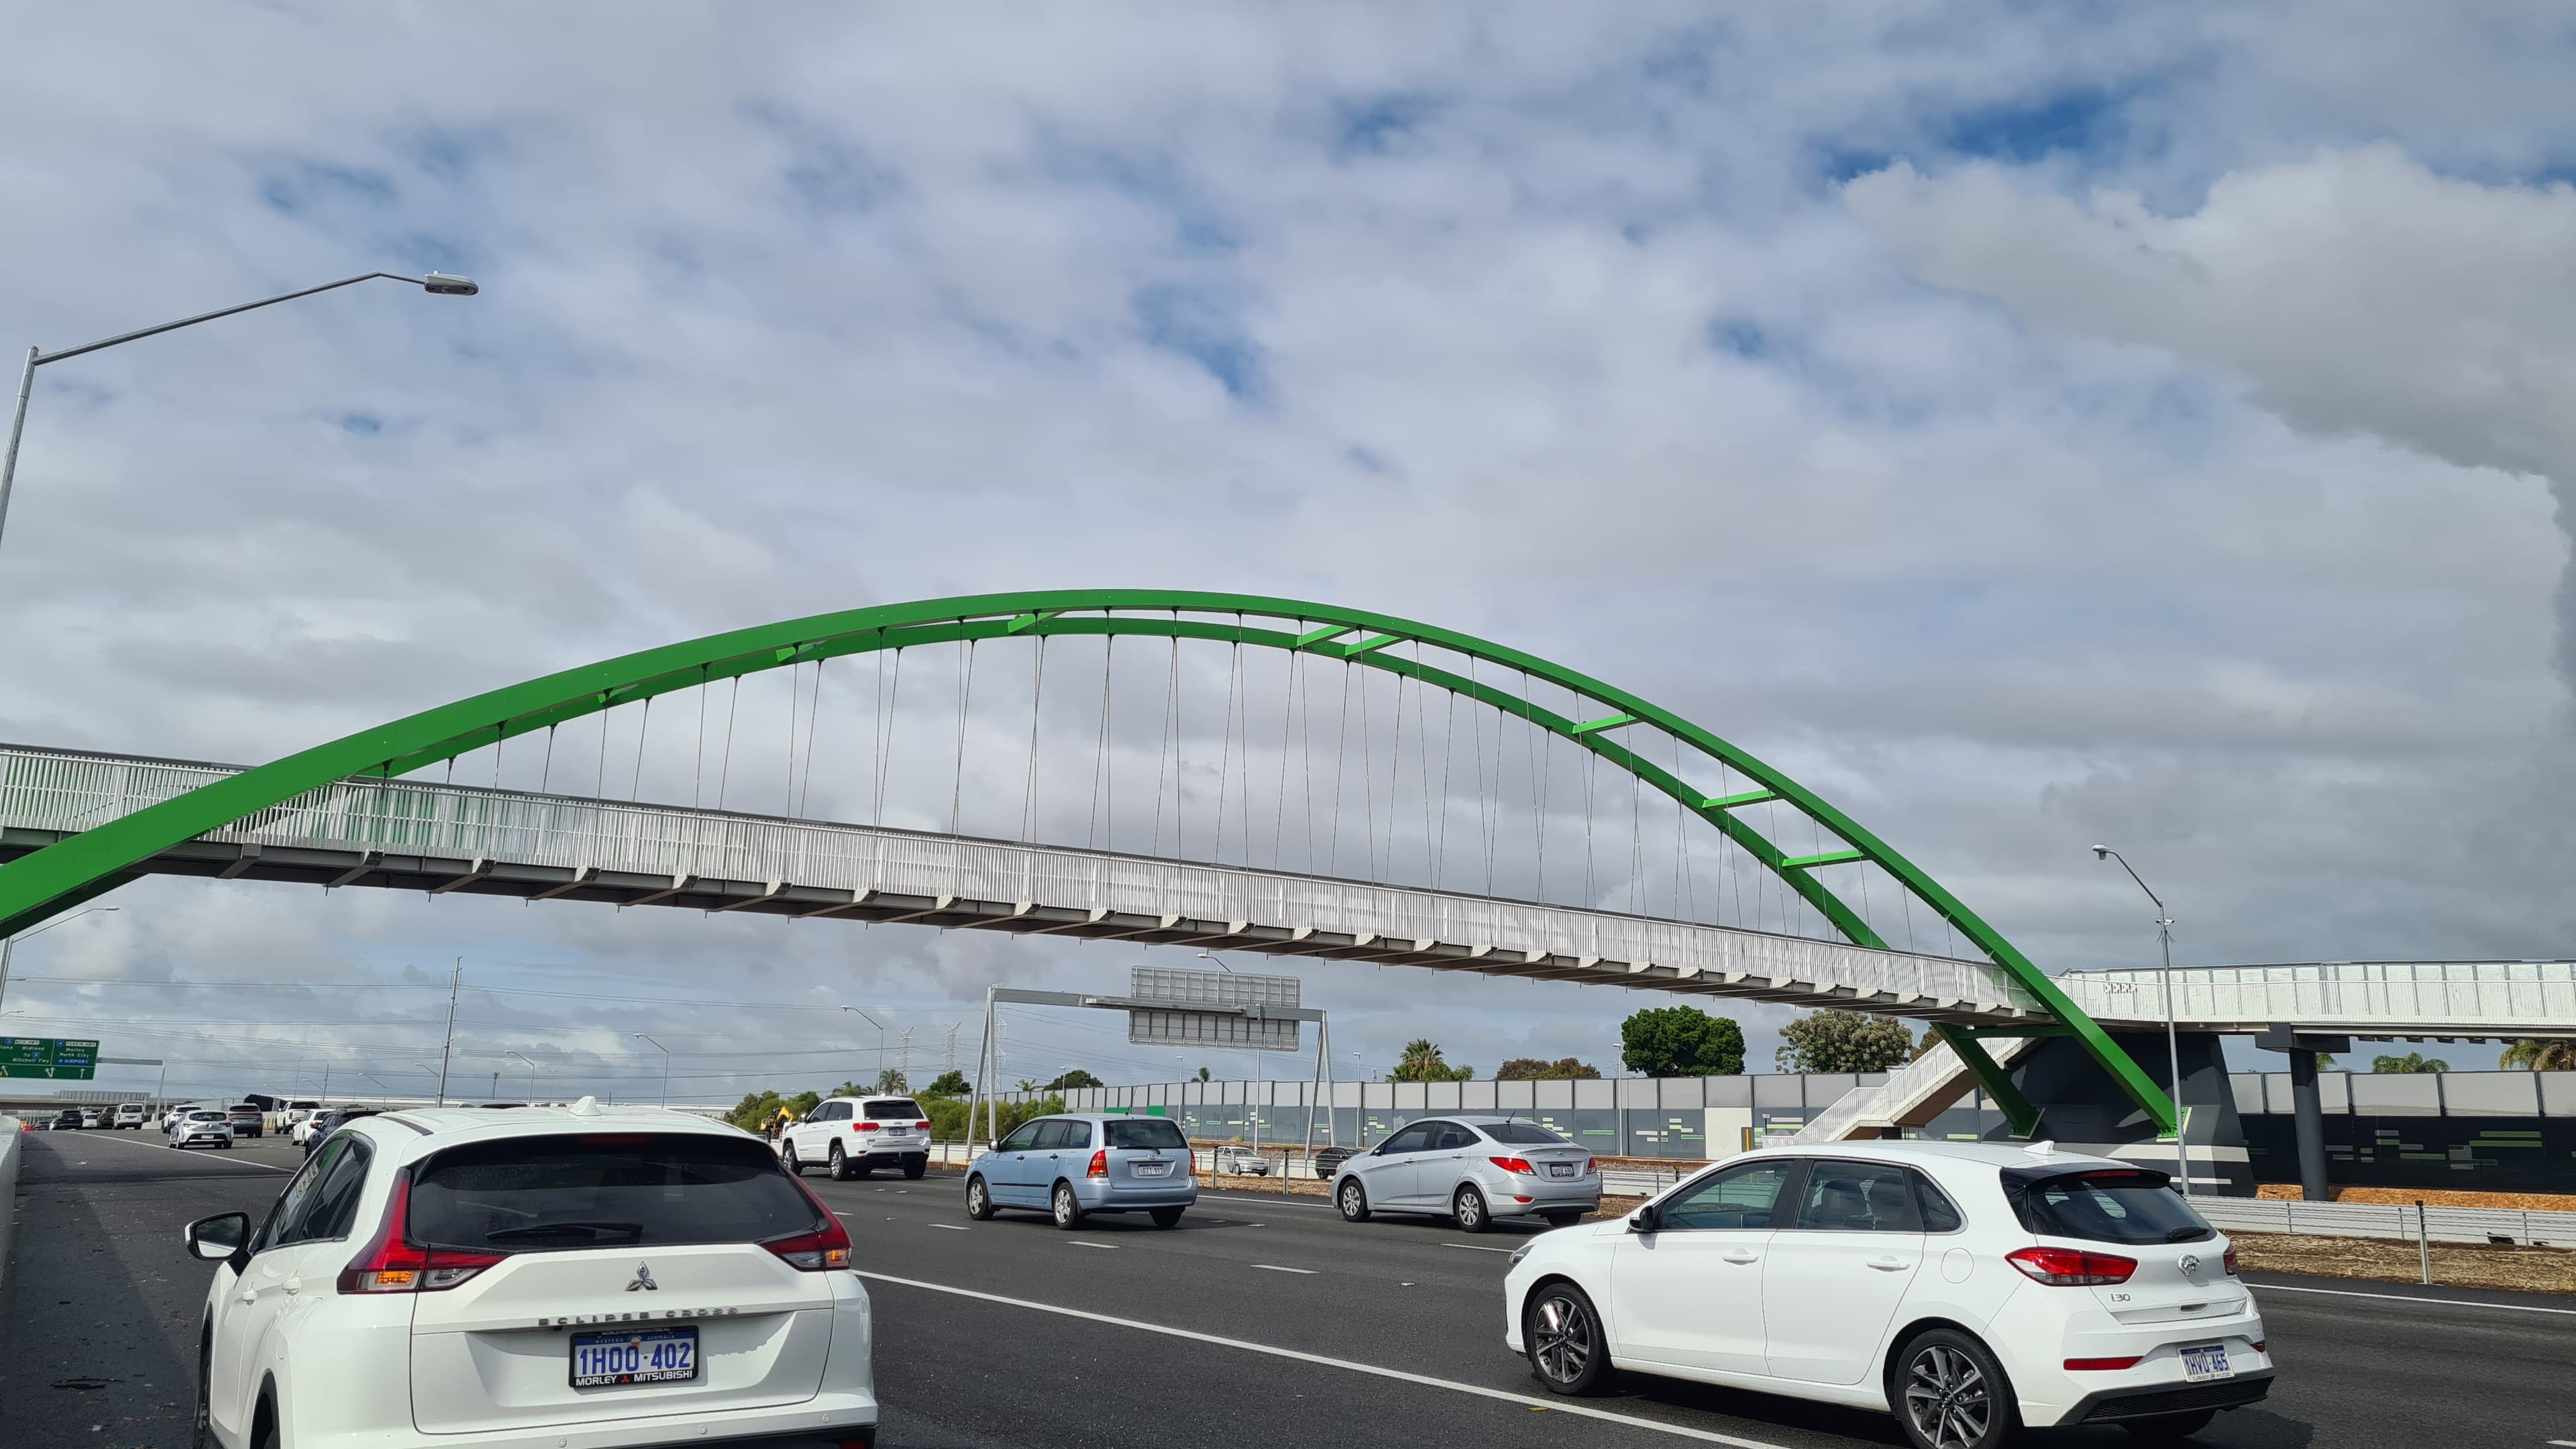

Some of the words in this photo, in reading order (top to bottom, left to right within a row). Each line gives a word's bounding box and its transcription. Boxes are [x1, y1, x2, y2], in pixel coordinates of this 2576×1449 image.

[539, 1311, 650, 1326] ECLIPSE
[665, 1307, 739, 1318] CROSS
[576, 1375, 617, 1387] MORLEY
[633, 1370, 693, 1383] MITSUBISHI
